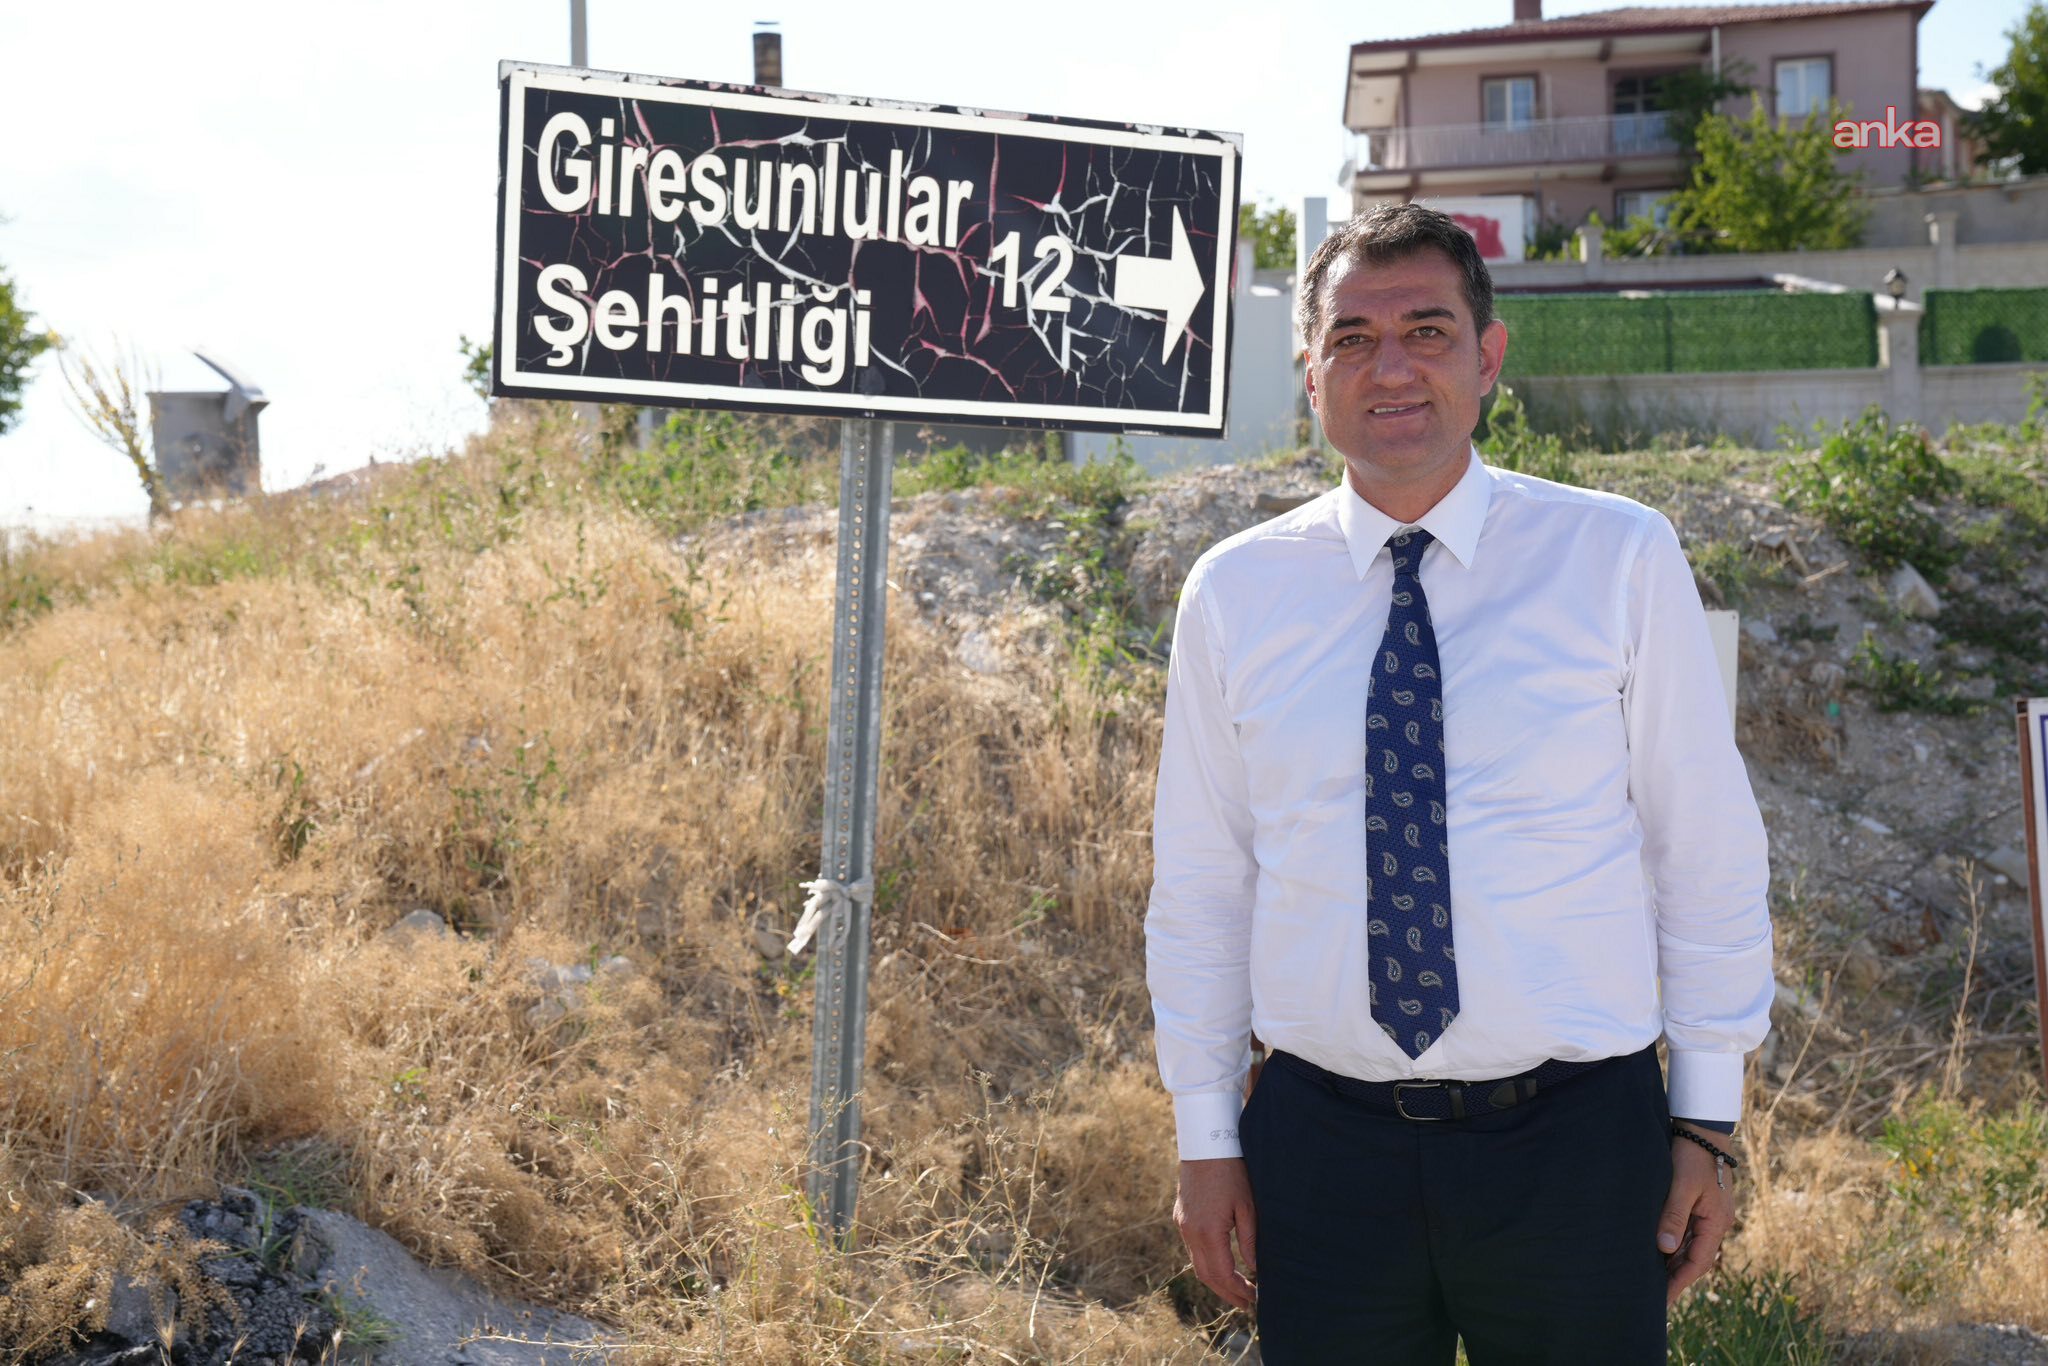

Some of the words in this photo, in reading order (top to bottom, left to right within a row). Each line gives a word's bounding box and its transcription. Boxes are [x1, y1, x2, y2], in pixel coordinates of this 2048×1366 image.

[537, 111, 973, 248] Giresunlular
[534, 263, 872, 387] Şehitliği
[994, 231, 1075, 312] 12
